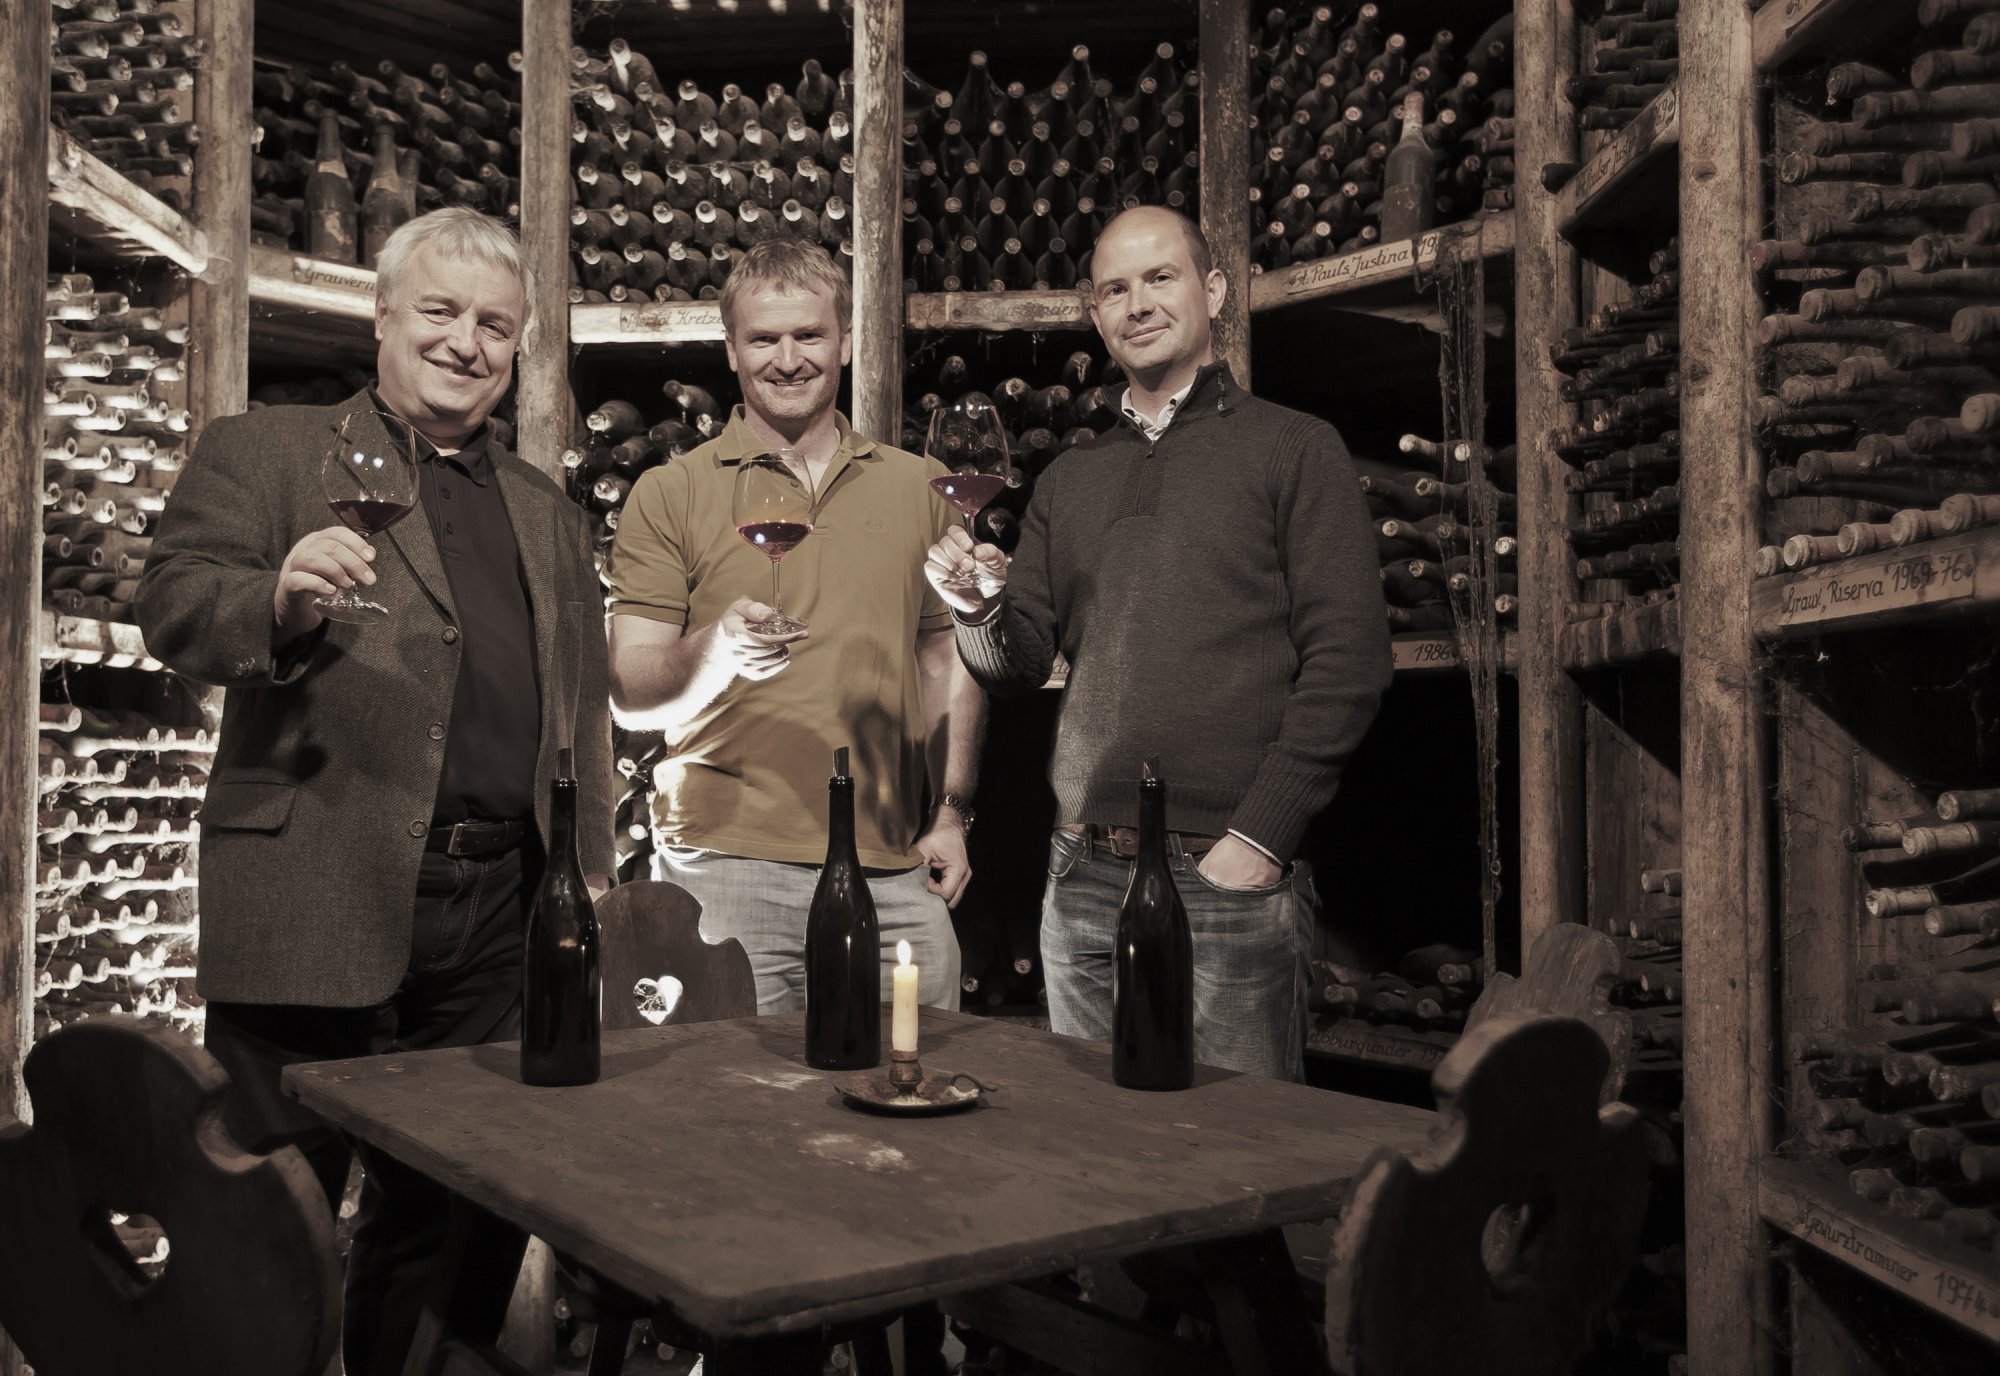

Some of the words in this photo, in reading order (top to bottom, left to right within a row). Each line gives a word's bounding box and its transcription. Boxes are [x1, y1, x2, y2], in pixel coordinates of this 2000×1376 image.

[303, 263, 377, 292] Grauvern
[1310, 261, 1350, 283] Pauls
[1350, 246, 1409, 281] Justina
[674, 310, 723, 326] Kretze
[1890, 553, 1963, 593] 1969-76
[1414, 642, 1451, 663] 1986
[1308, 1030, 1411, 1058] eißburgunder
